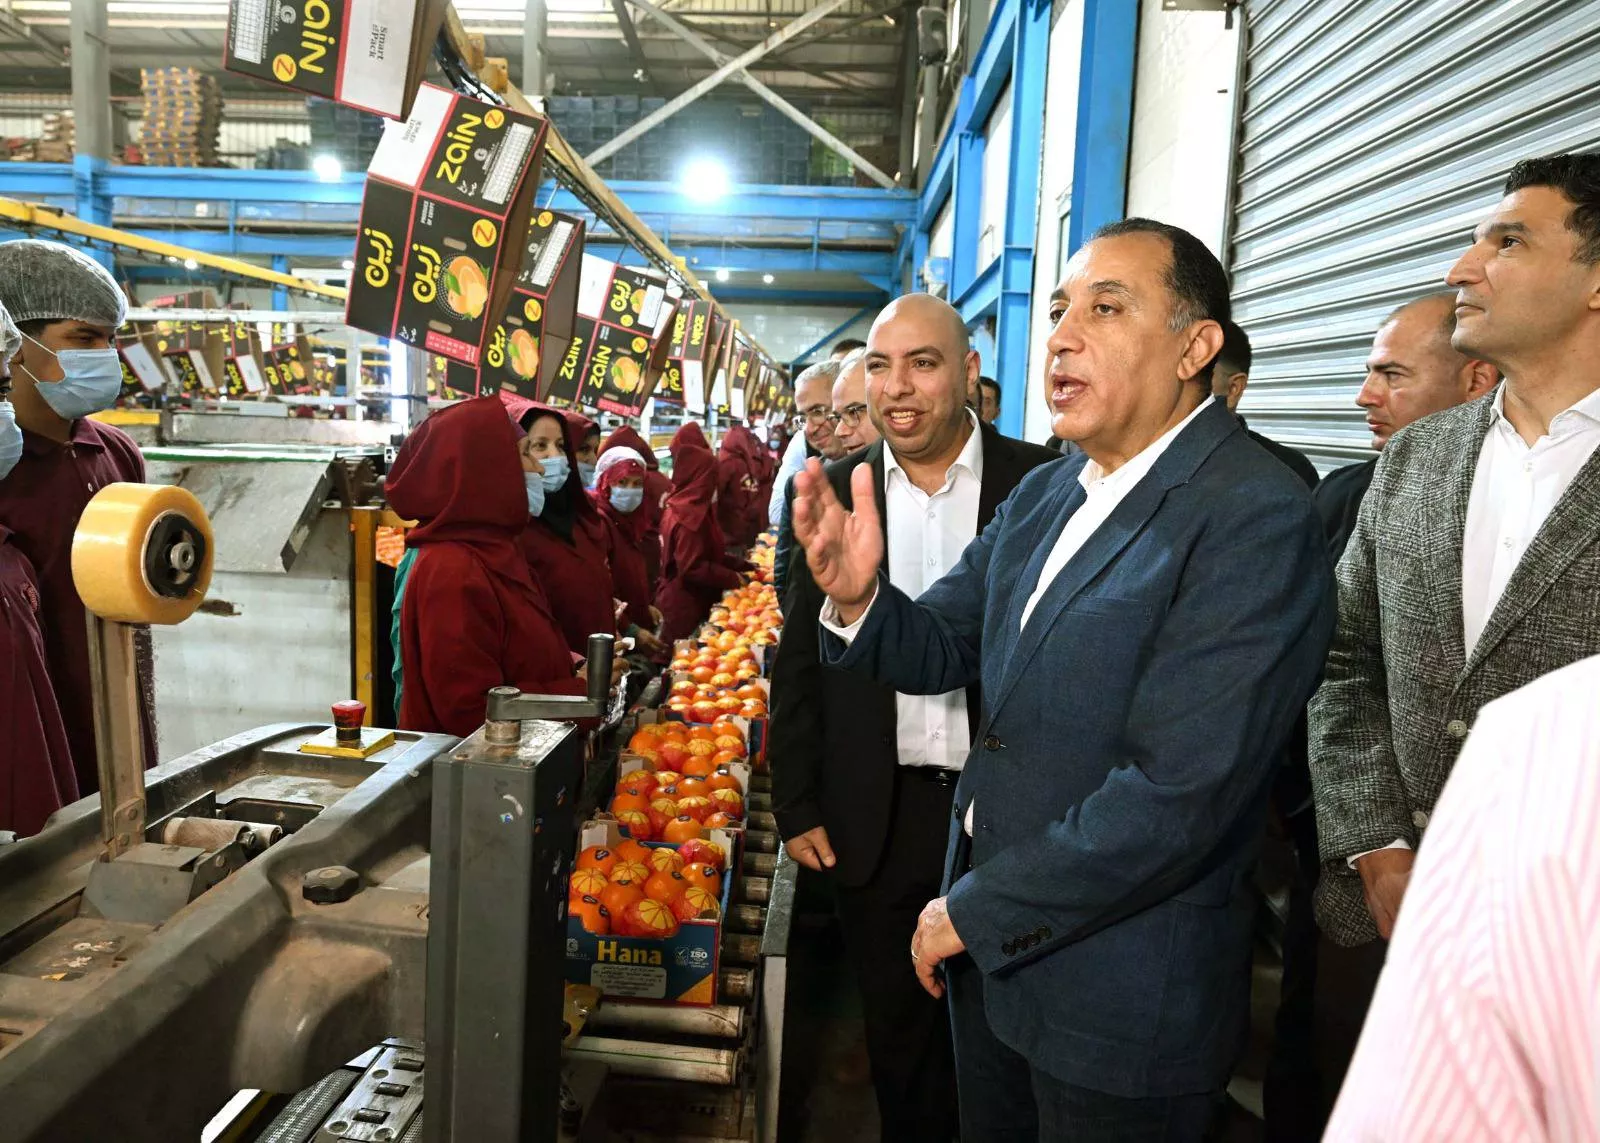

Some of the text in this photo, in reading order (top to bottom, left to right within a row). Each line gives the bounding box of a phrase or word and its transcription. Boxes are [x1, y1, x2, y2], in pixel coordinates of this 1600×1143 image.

[299, 0, 336, 74] aiN
[369, 31, 379, 58] Pack
[377, 27, 388, 60] Smart
[365, 228, 393, 288] زين
[412, 243, 441, 304] زين
[611, 278, 632, 312] زين
[597, 939, 663, 965] Hana
[690, 950, 708, 959] ISO
